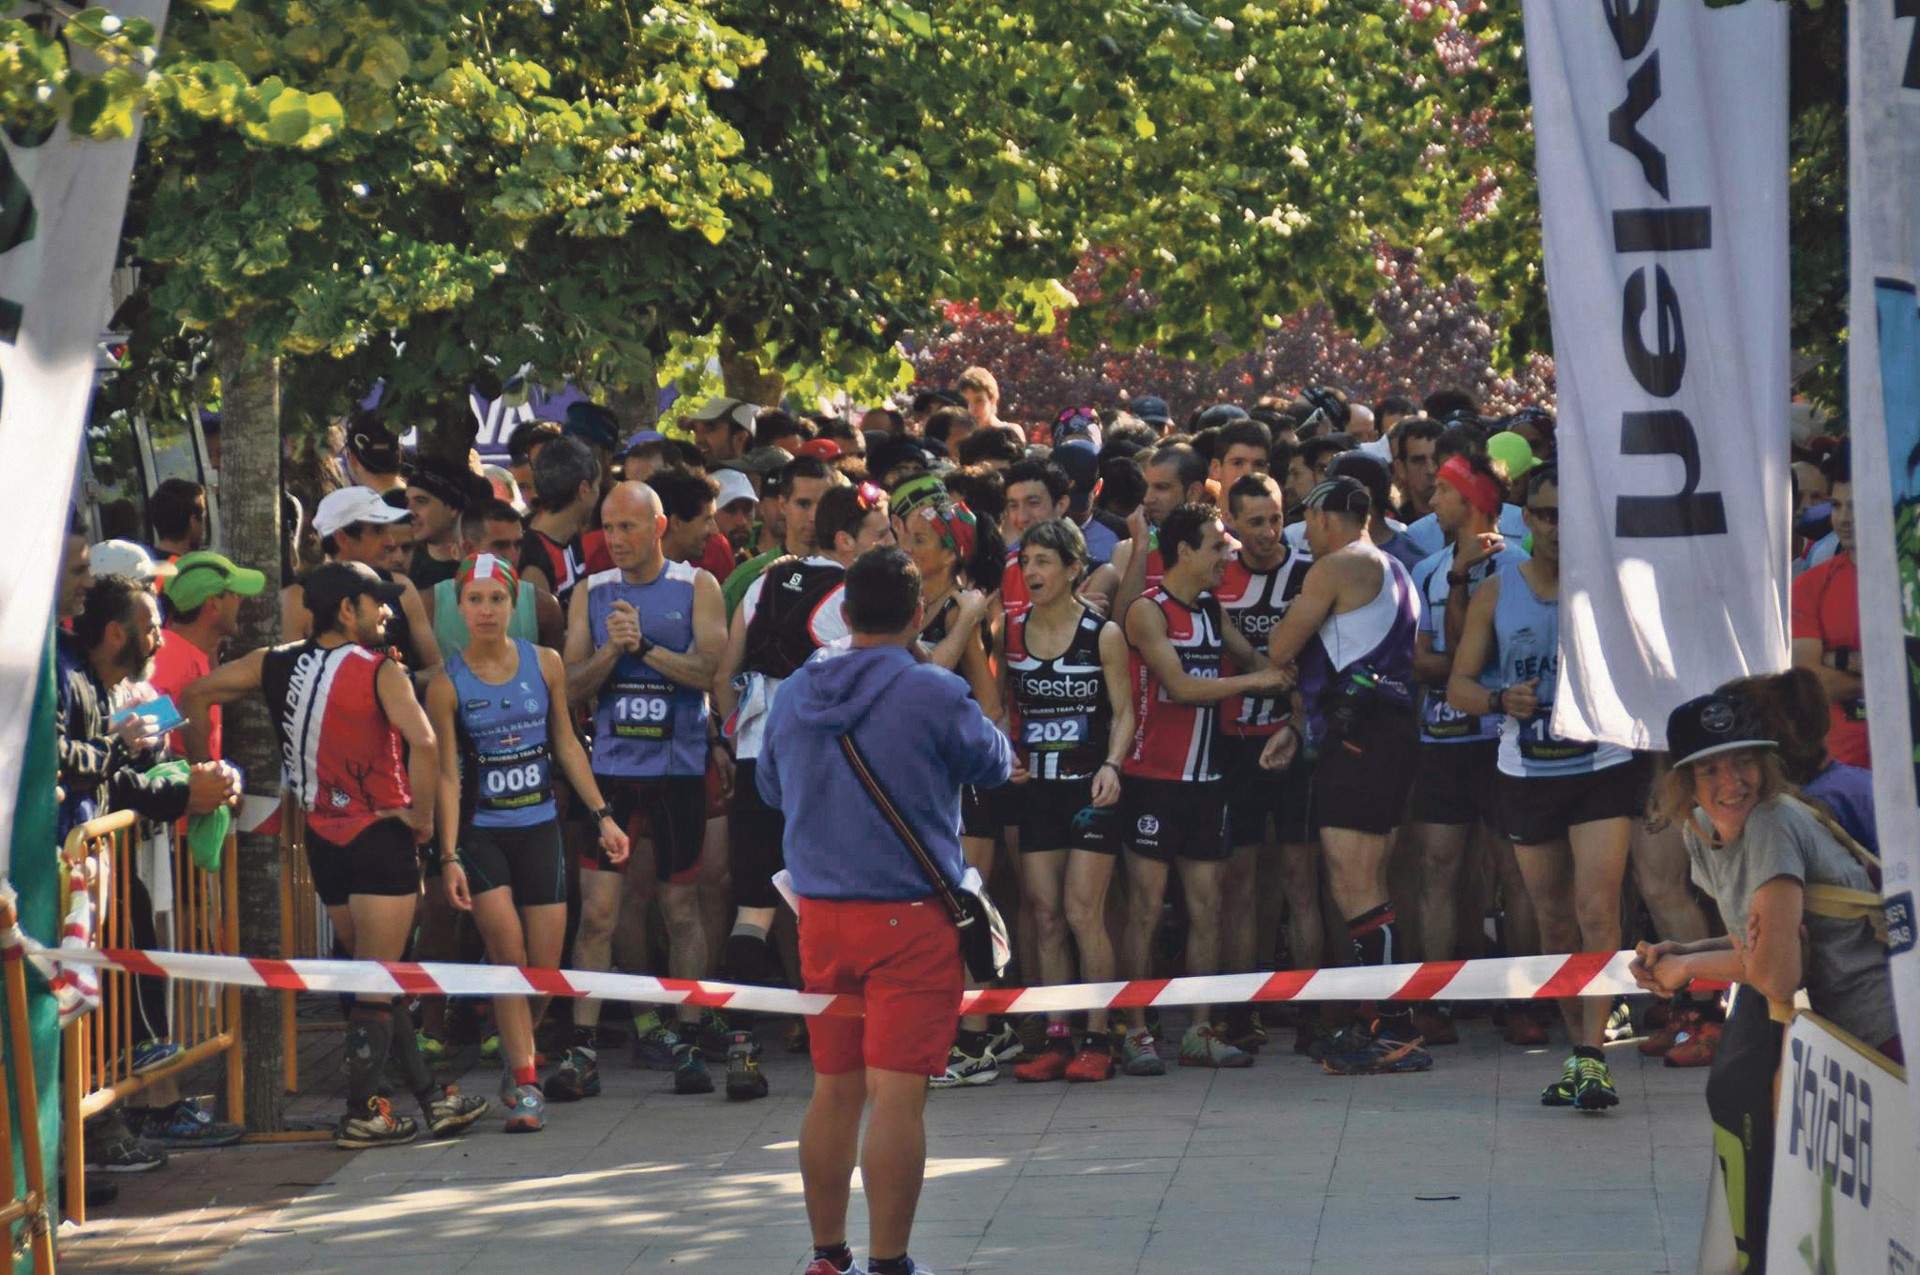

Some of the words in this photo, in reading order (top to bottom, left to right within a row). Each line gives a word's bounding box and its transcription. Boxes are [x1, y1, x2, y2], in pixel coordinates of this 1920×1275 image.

[615, 696, 668, 721] 199
[1027, 720, 1079, 743] 202
[486, 763, 541, 793] 008
